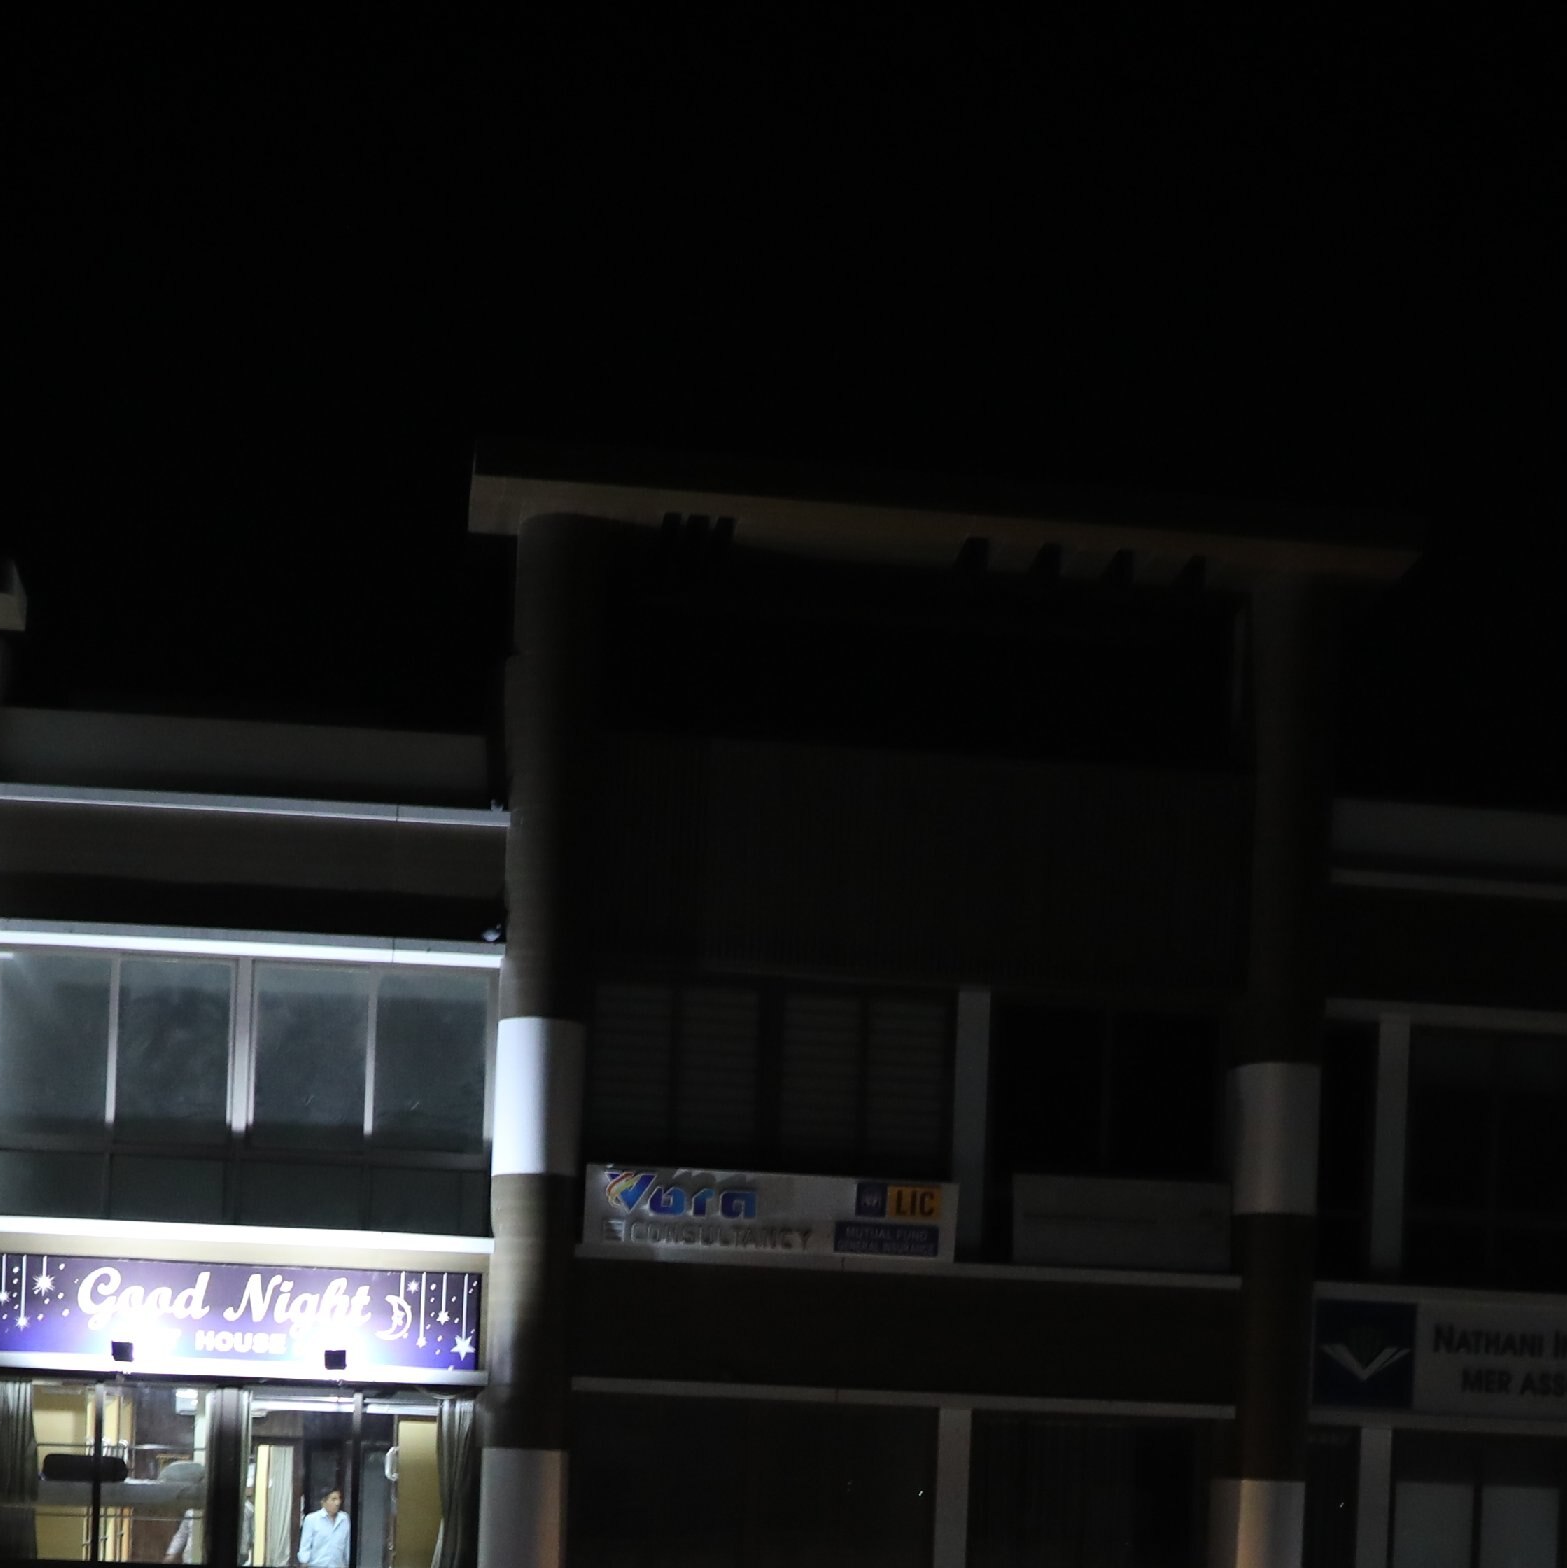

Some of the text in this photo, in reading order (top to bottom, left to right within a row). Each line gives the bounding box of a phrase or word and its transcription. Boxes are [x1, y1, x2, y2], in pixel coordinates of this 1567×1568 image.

[605, 1170, 757, 1218] Vora
[895, 1189, 935, 1217] LIC
[631, 1221, 812, 1251] CONSULTANCY
[76, 1266, 372, 1340] Good Night
[195, 1329, 288, 1355] HOUSE
[1462, 1368, 1511, 1395] MER
